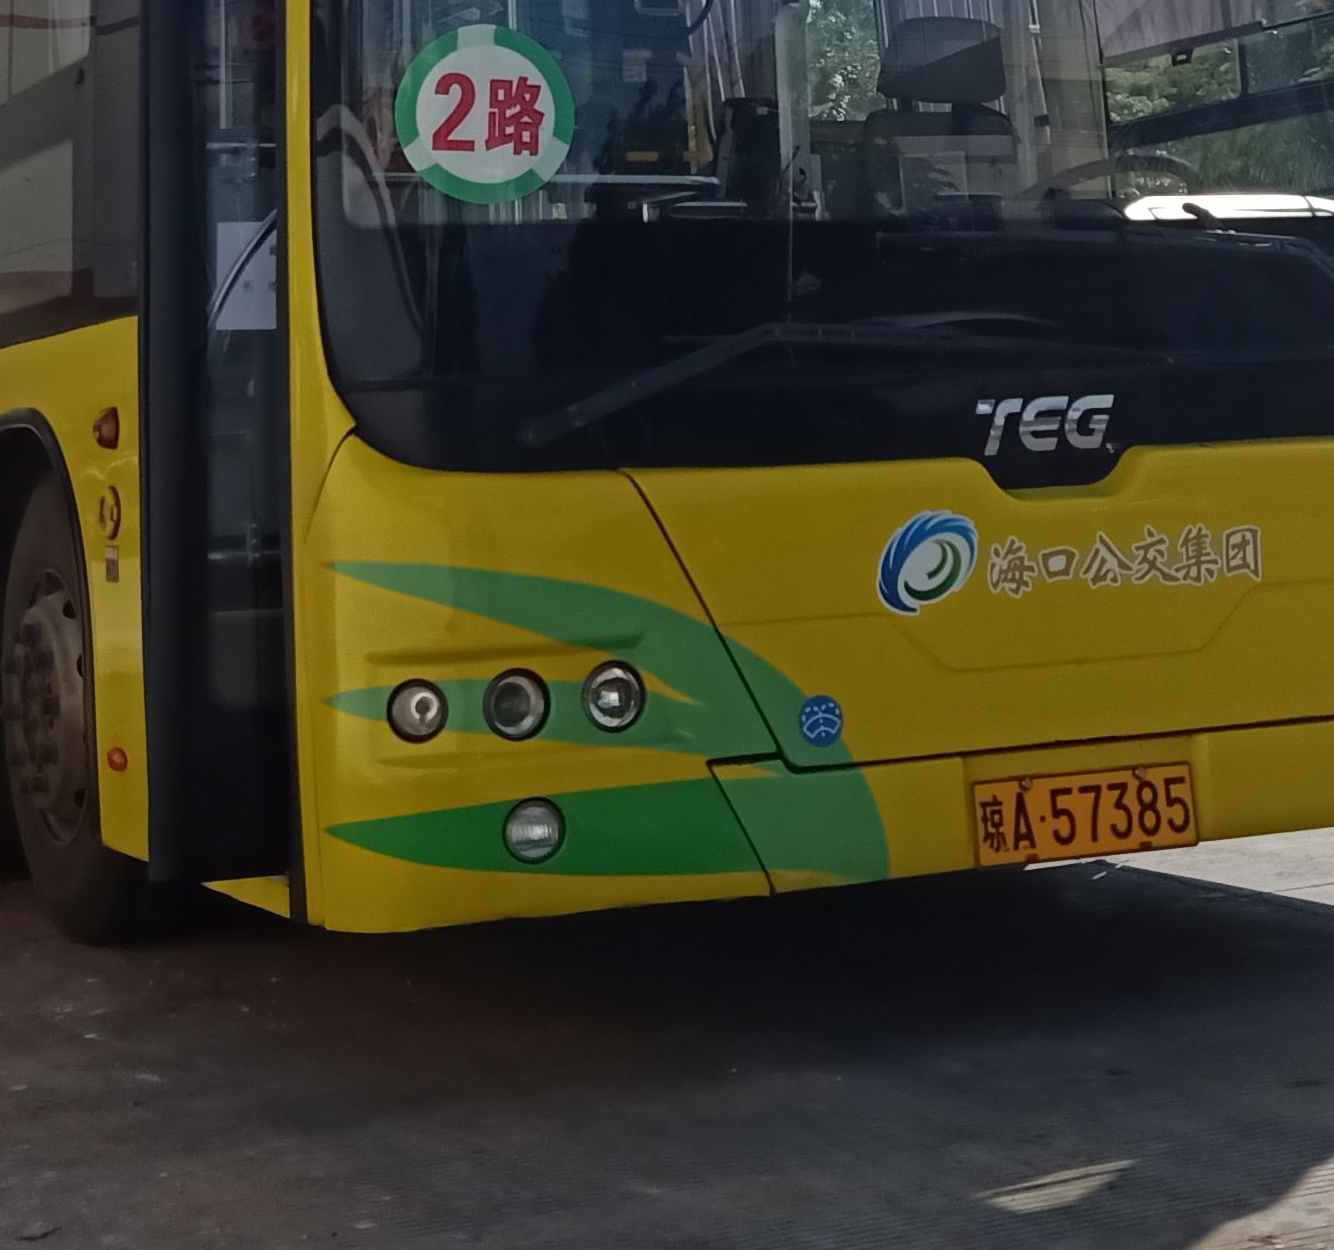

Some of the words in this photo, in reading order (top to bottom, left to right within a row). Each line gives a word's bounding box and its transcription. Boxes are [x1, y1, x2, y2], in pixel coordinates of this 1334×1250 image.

[431, 72, 546, 157] 2路
[975, 393, 1115, 457] TEG
[987, 524, 1264, 598] 海口公交集团
